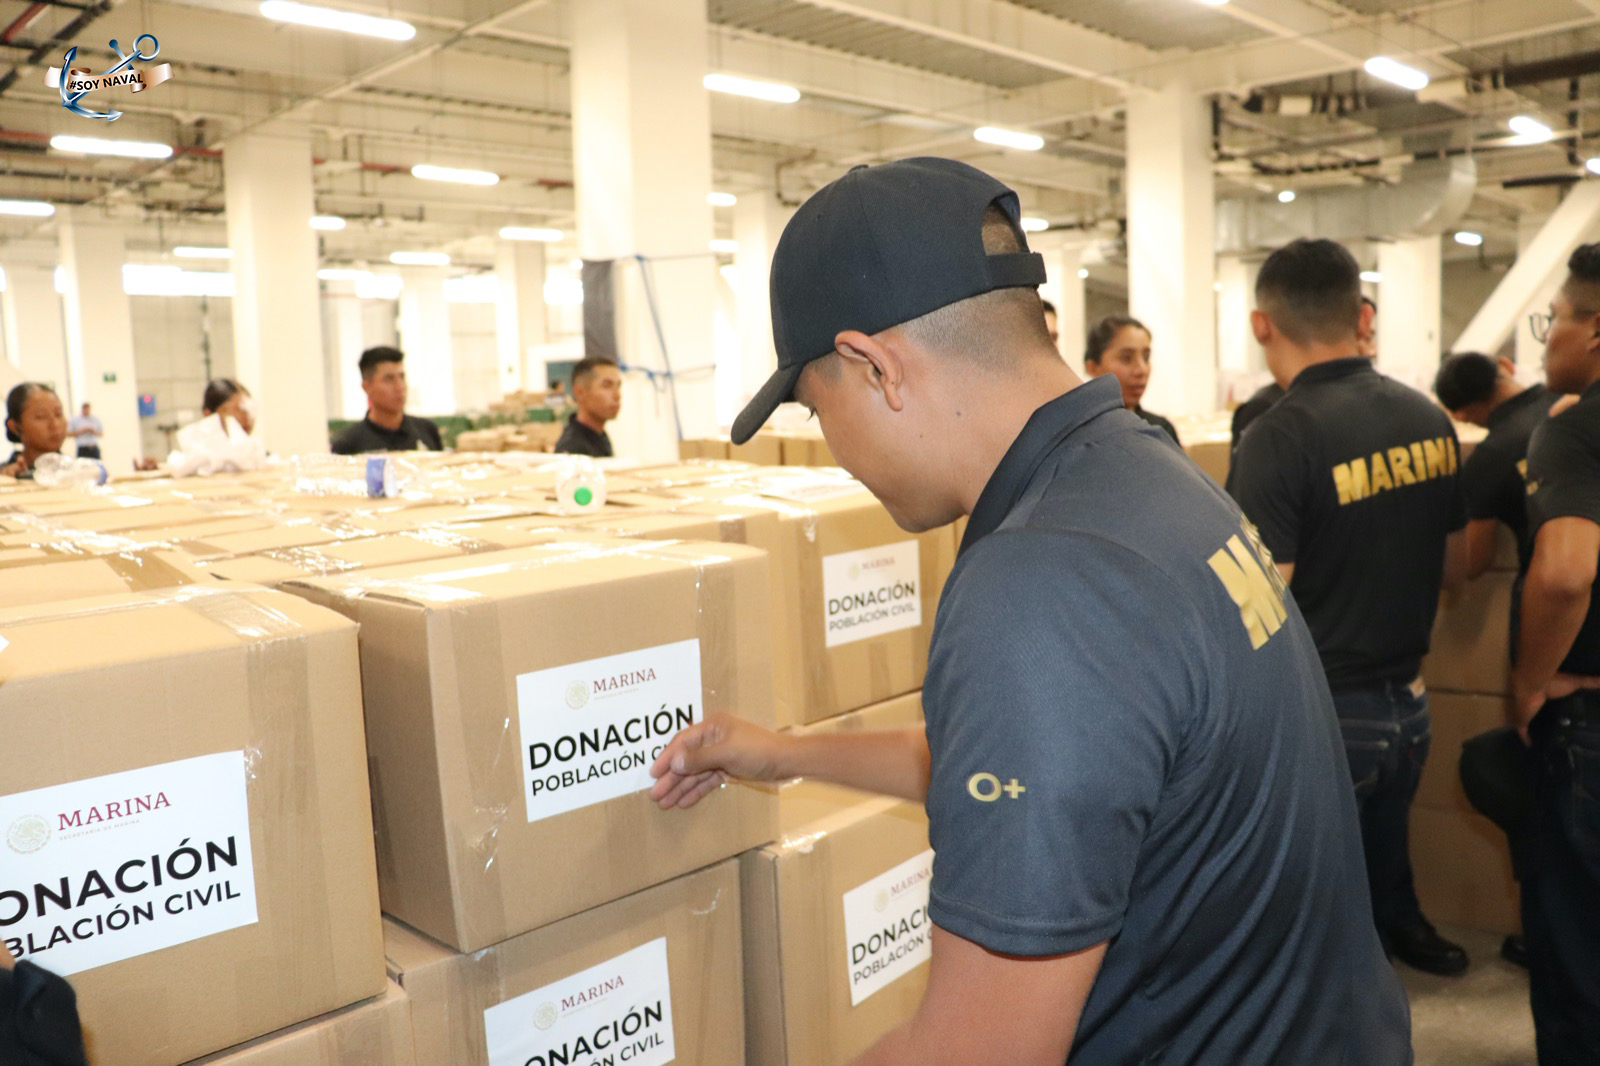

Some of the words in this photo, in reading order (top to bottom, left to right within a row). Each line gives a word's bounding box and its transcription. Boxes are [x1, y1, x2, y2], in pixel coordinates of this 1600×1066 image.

[828, 580, 915, 615] DONACIÓN
[593, 668, 657, 693] MARINA
[529, 704, 694, 770] DONACIÓN
[532, 750, 646, 796] POBLACIÓN
[57, 792, 171, 831] MARINA
[0, 836, 238, 927] ONACIÓN
[4, 901, 155, 959] BLACIÓN
[164, 880, 241, 915] CIVIL
[852, 905, 927, 965] DONACI
[561, 975, 625, 1011] MARINA
[620, 1032, 665, 1061] CIVIL
